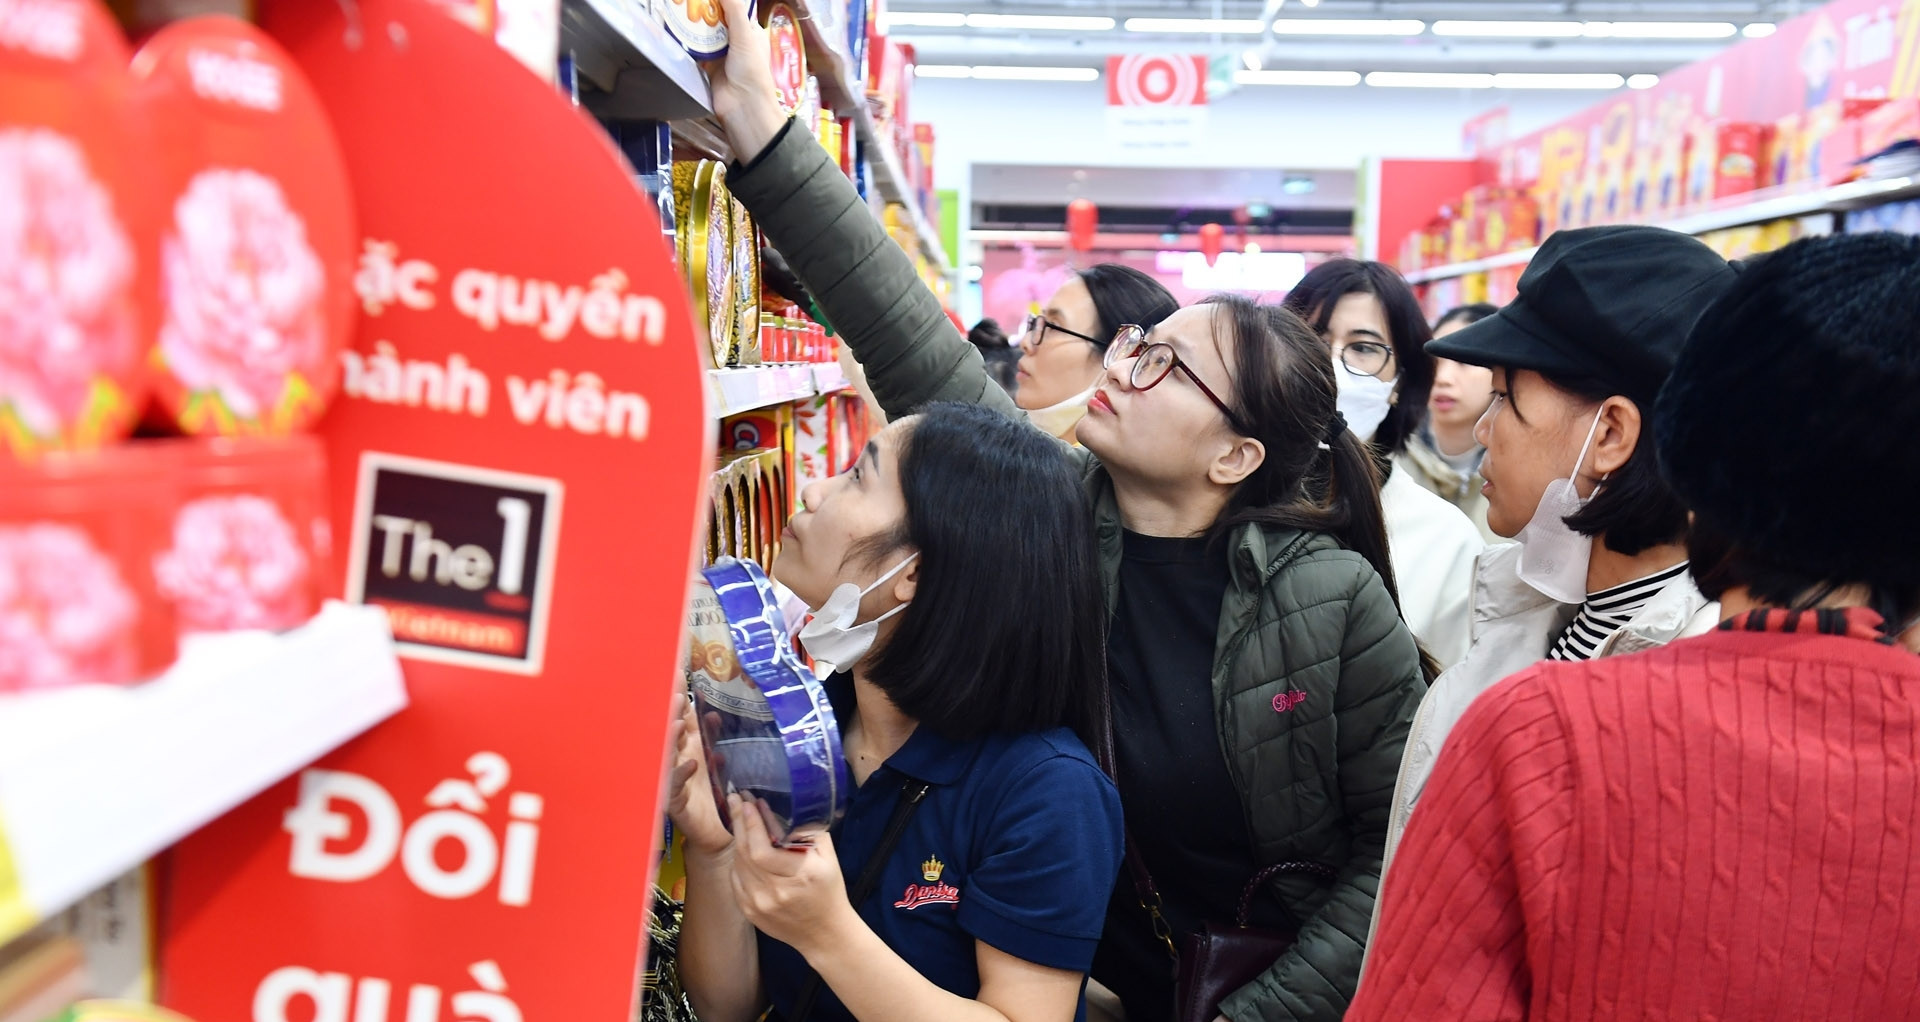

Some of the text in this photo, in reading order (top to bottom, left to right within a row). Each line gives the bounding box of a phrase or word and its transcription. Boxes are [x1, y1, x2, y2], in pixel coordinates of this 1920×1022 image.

[354, 238, 438, 317] ặc
[341, 340, 651, 441] ành viên
[373, 514, 495, 591] The
[281, 750, 544, 908] Đổi
